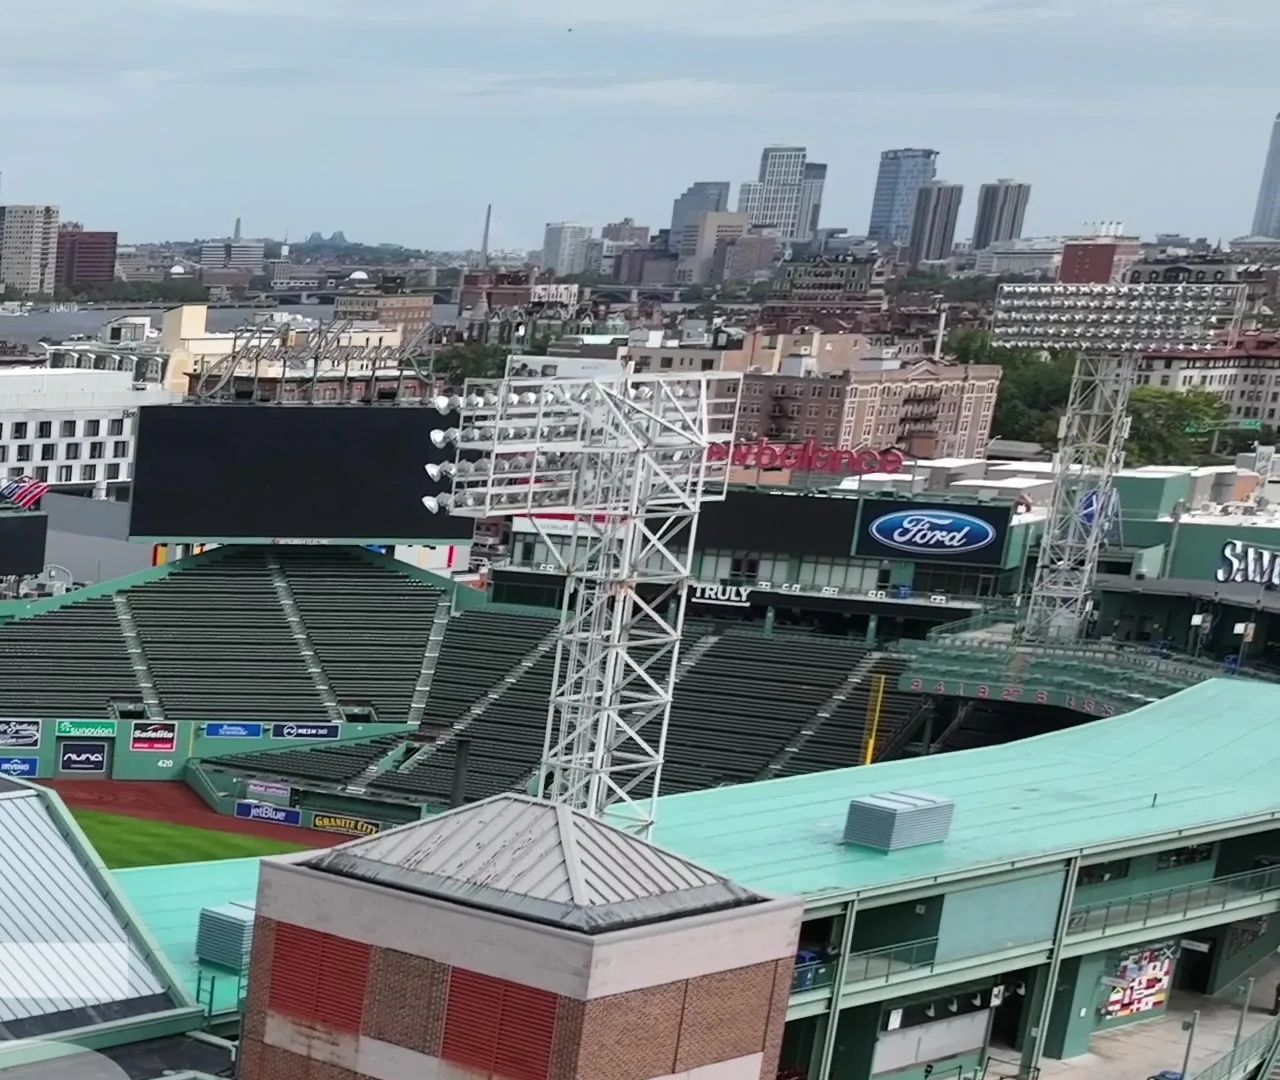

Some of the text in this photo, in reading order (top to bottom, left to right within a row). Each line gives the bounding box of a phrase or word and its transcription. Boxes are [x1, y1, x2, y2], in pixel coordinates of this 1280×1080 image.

[892, 515, 971, 546] Ford
[692, 585, 753, 602] TRULY
[1000, 687, 1023, 701] 27
[133, 729, 174, 739] Safelite
[156, 759, 174, 768] 420
[250, 806, 287, 821] jetBlue
[315, 816, 356, 830] GRANITE
[357, 821, 379, 835] CITY
